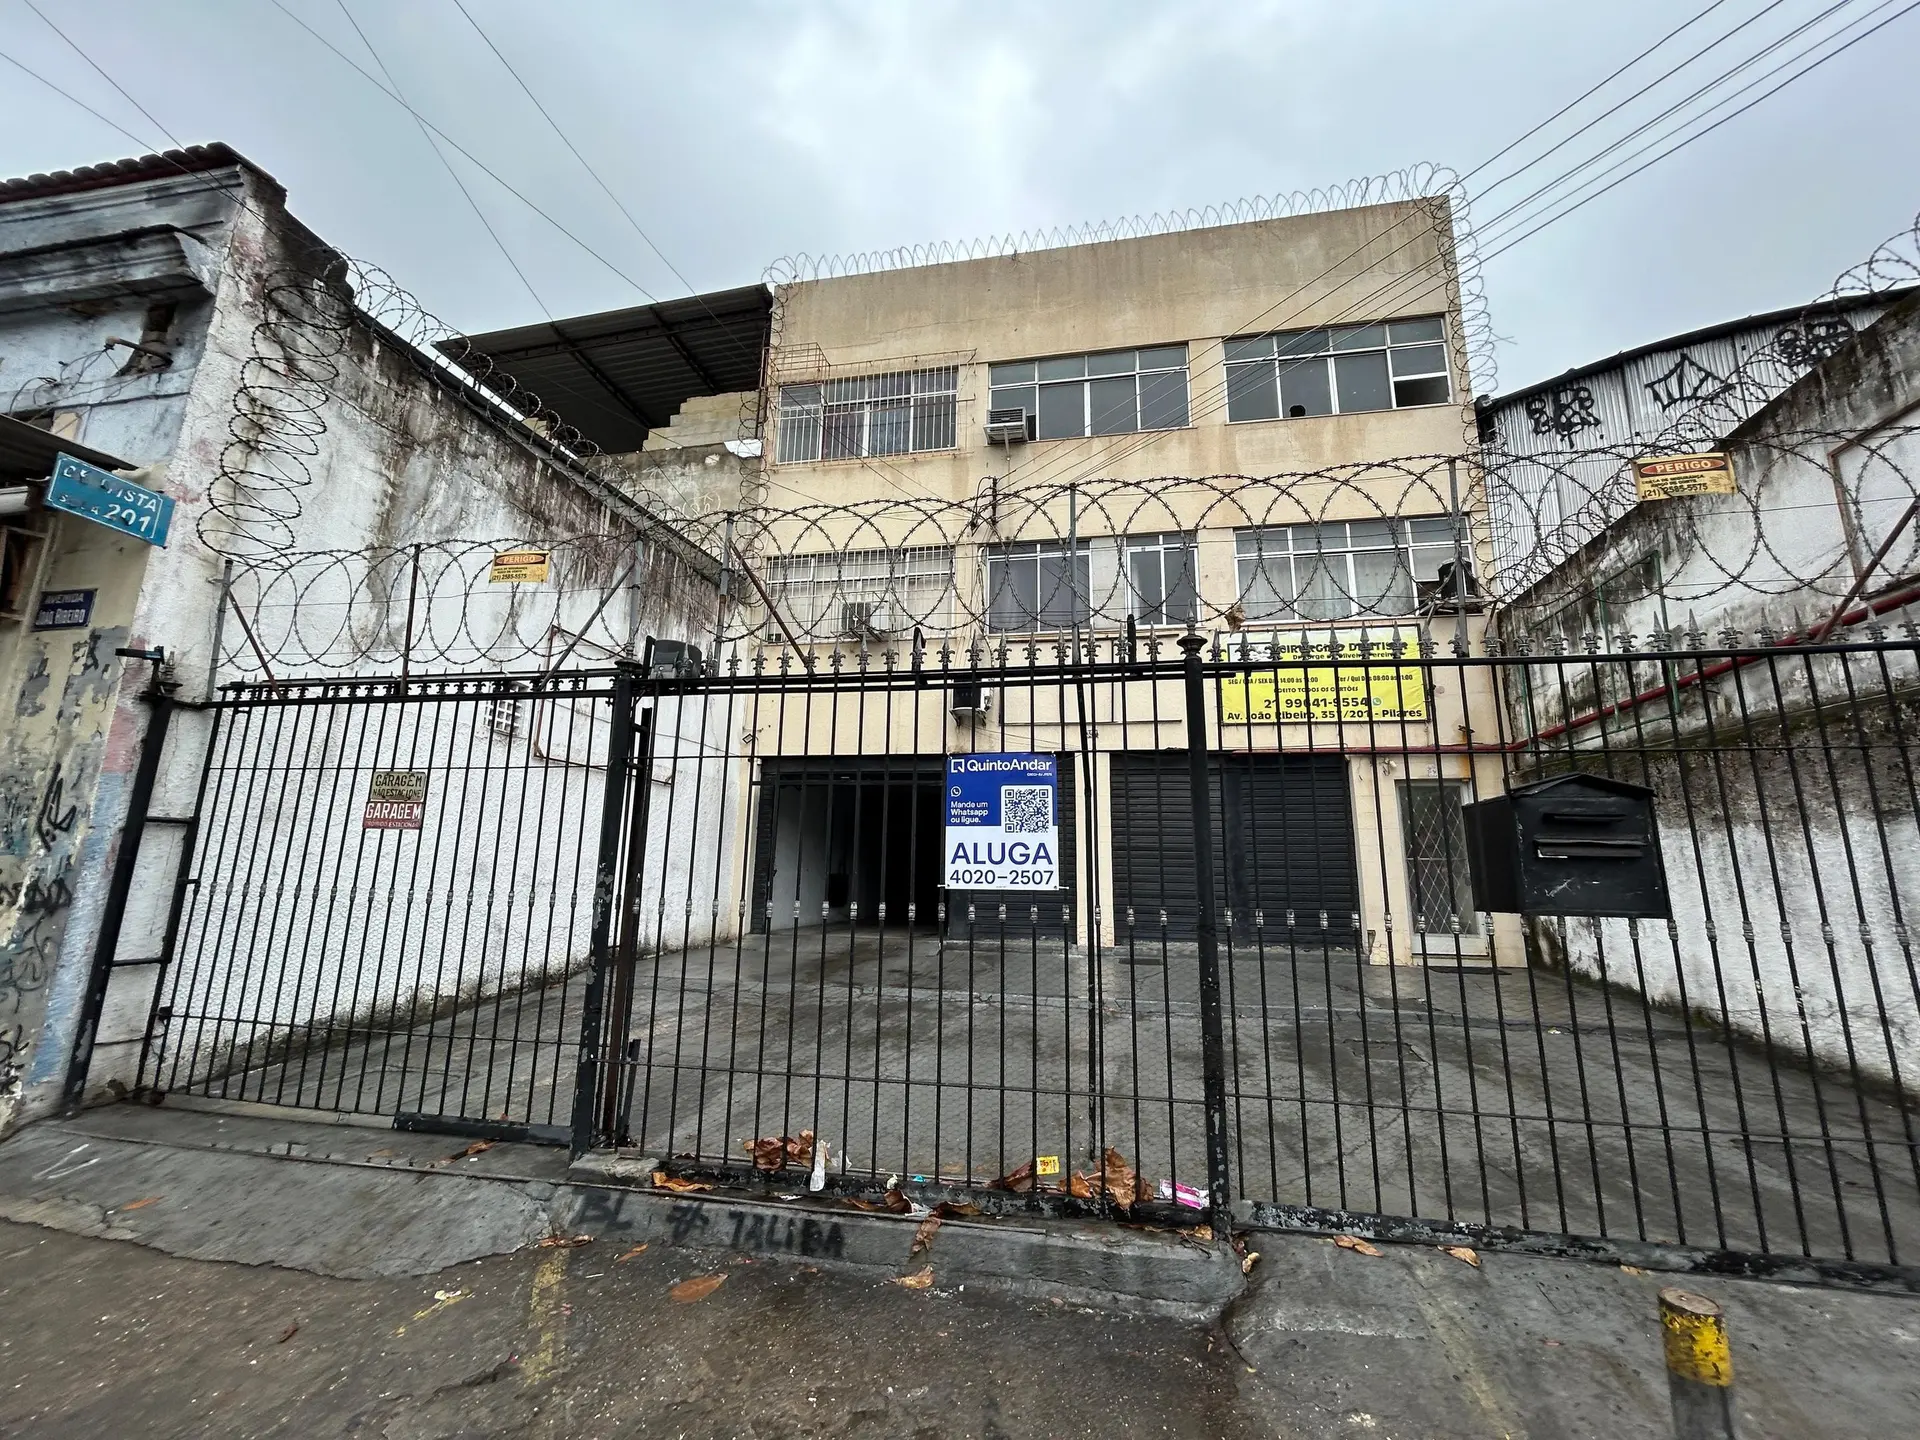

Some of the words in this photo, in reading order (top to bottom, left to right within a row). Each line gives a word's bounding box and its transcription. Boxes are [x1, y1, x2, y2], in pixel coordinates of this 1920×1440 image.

[1655, 460, 1712, 473] PERIGO
[1643, 488, 1660, 499] (21)
[504, 556, 536, 564] PERIGO
[1227, 712, 1243, 720] Av.
[1246, 711, 1271, 720] oão
[1321, 710, 1371, 719] 35/20
[1382, 710, 1422, 718] Pilares
[967, 759, 1052, 772] QuintoAndar
[375, 774, 422, 788] GARAGEM
[366, 803, 422, 819] GARAGEM
[951, 809, 989, 817] Whatsapp
[961, 816, 981, 824] ligue.
[950, 842, 1053, 865] ALUGA
[950, 869, 1054, 885] 4020-2507
